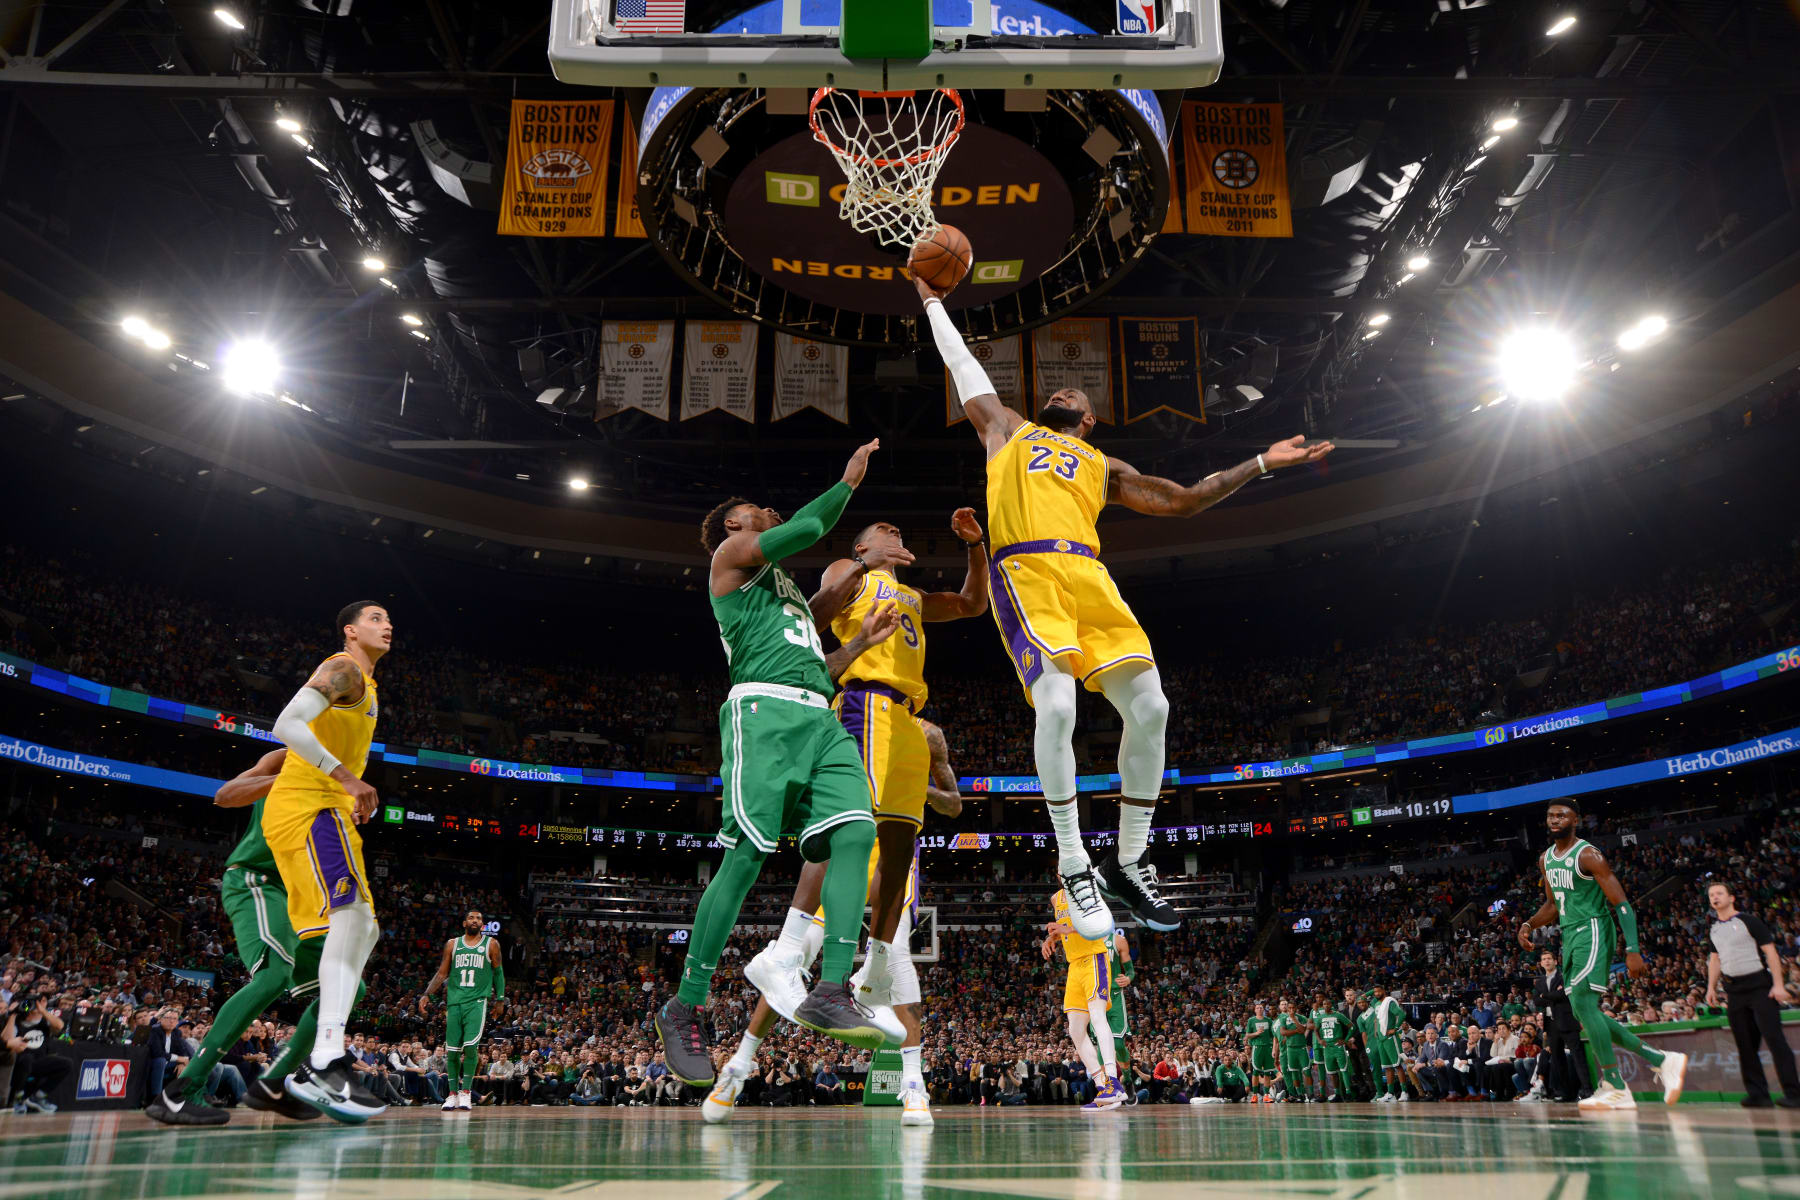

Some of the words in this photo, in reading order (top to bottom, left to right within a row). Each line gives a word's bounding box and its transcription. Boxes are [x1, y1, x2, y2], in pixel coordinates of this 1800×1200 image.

[1123, 19, 1142, 32] NBA
[524, 104, 601, 123] BOSTON
[1195, 106, 1271, 125] BOSTON
[521, 124, 598, 144] BRUINS
[1195, 125, 1272, 145] BRUINS
[770, 178, 815, 201] TD
[516, 191, 568, 204] STANLEY
[570, 192, 593, 204] CUP
[1200, 191, 1250, 205] STANLEY
[1254, 194, 1276, 206] CUP
[513, 205, 593, 218] CHAMPIONS
[1199, 205, 1278, 220] CHAMPIONS
[538, 220, 567, 232] 1929
[1226, 220, 1253, 232] 2011
[771, 257, 912, 281] RDEN
[977, 264, 1018, 281] TD
[1138, 322, 1179, 332] BOSTON
[1139, 332, 1179, 343] BRUINS
[1028, 445, 1081, 481] 23
[900, 612, 920, 650] 9
[1776, 648, 1800, 672] 36
[214, 713, 237, 733] 36
[244, 722, 277, 741] Bran
[1484, 726, 1505, 745] 60
[1512, 714, 1584, 739] Locations.
[0, 739, 131, 781] erbChambers.com
[469, 758, 491, 775] 60
[497, 764, 564, 783] Locations.
[1233, 764, 1254, 781] 36
[1261, 761, 1309, 778] Brands.
[972, 777, 993, 792] 60
[386, 808, 402, 821] TD
[406, 811, 435, 823] Bank
[1353, 810, 1369, 822] TD
[1373, 806, 1403, 818] Bank
[1405, 799, 1450, 817] 10:19
[467, 818, 483, 826] 3:04
[1312, 816, 1328, 825] 3:04
[519, 824, 537, 837] 24
[1254, 822, 1273, 836] 24
[592, 834, 604, 842] 45
[613, 835, 625, 843] 34
[676, 839, 701, 848] 15/35
[919, 835, 946, 848] 115
[948, 833, 991, 850] LAKERS
[1034, 840, 1046, 848] 51
[1148, 835, 1155, 843] 4
[1167, 834, 1179, 842] 31
[1187, 833, 1199, 841] 39
[1554, 891, 1566, 916] 7
[488, 921, 501, 932] 10
[1298, 917, 1312, 929] 10
[675, 929, 689, 941] 10
[455, 953, 485, 969] BOSTON
[459, 969, 476, 987] 11
[1323, 1028, 1334, 1039] 12
[81, 1067, 100, 1091] NBA
[871, 1074, 904, 1083] EQUALIT
